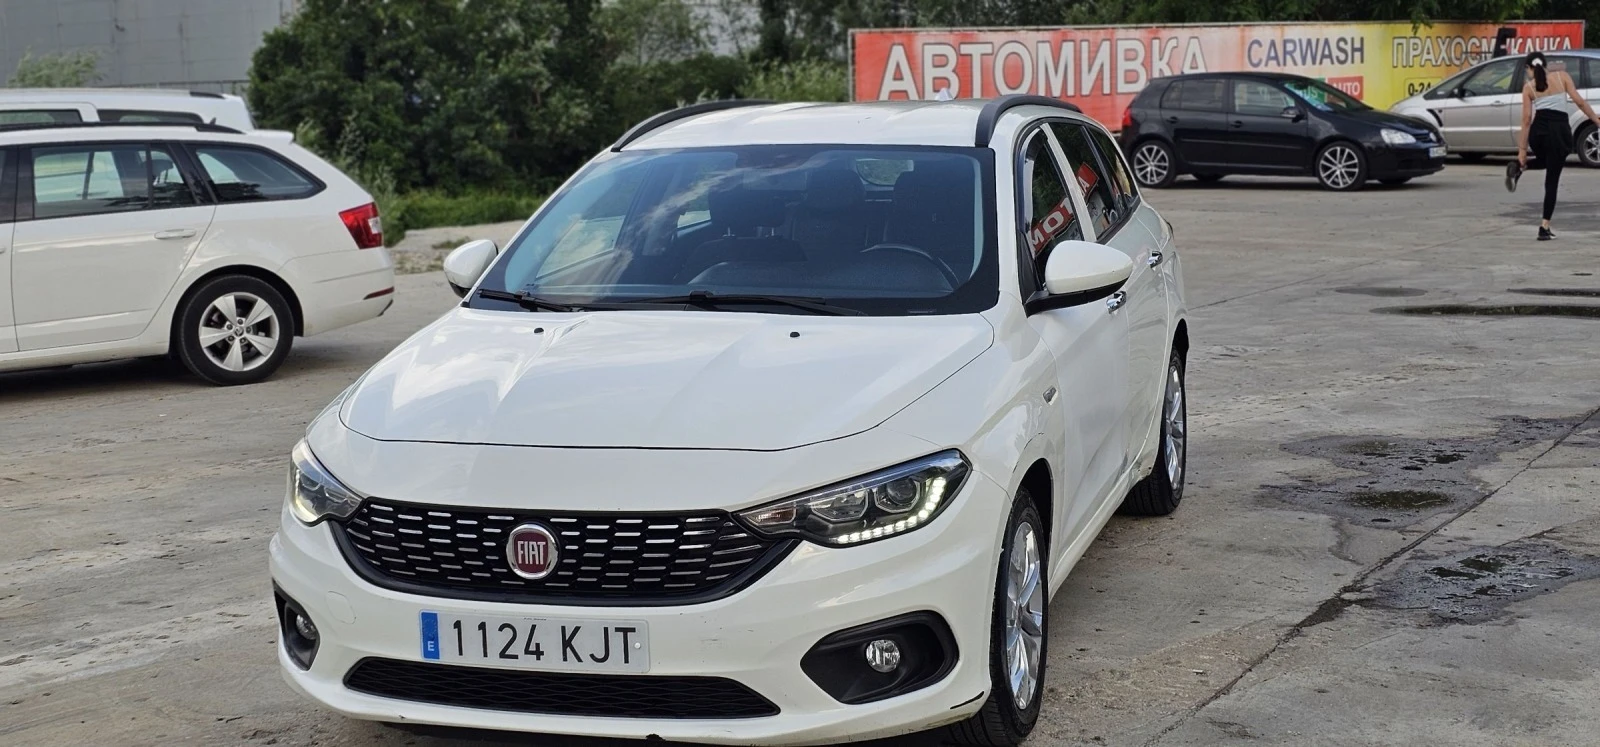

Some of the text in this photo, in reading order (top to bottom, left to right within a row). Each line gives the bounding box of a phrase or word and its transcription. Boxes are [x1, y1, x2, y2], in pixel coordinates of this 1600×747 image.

[1247, 36, 1365, 68] CARWASH
[1392, 36, 1572, 67] ПРАХОСМКАЧКА
[877, 36, 1208, 100] АВТОМИВКА
[517, 541, 546, 565] FIAT
[427, 640, 435, 651] E
[453, 620, 636, 664] 1124 KJT
